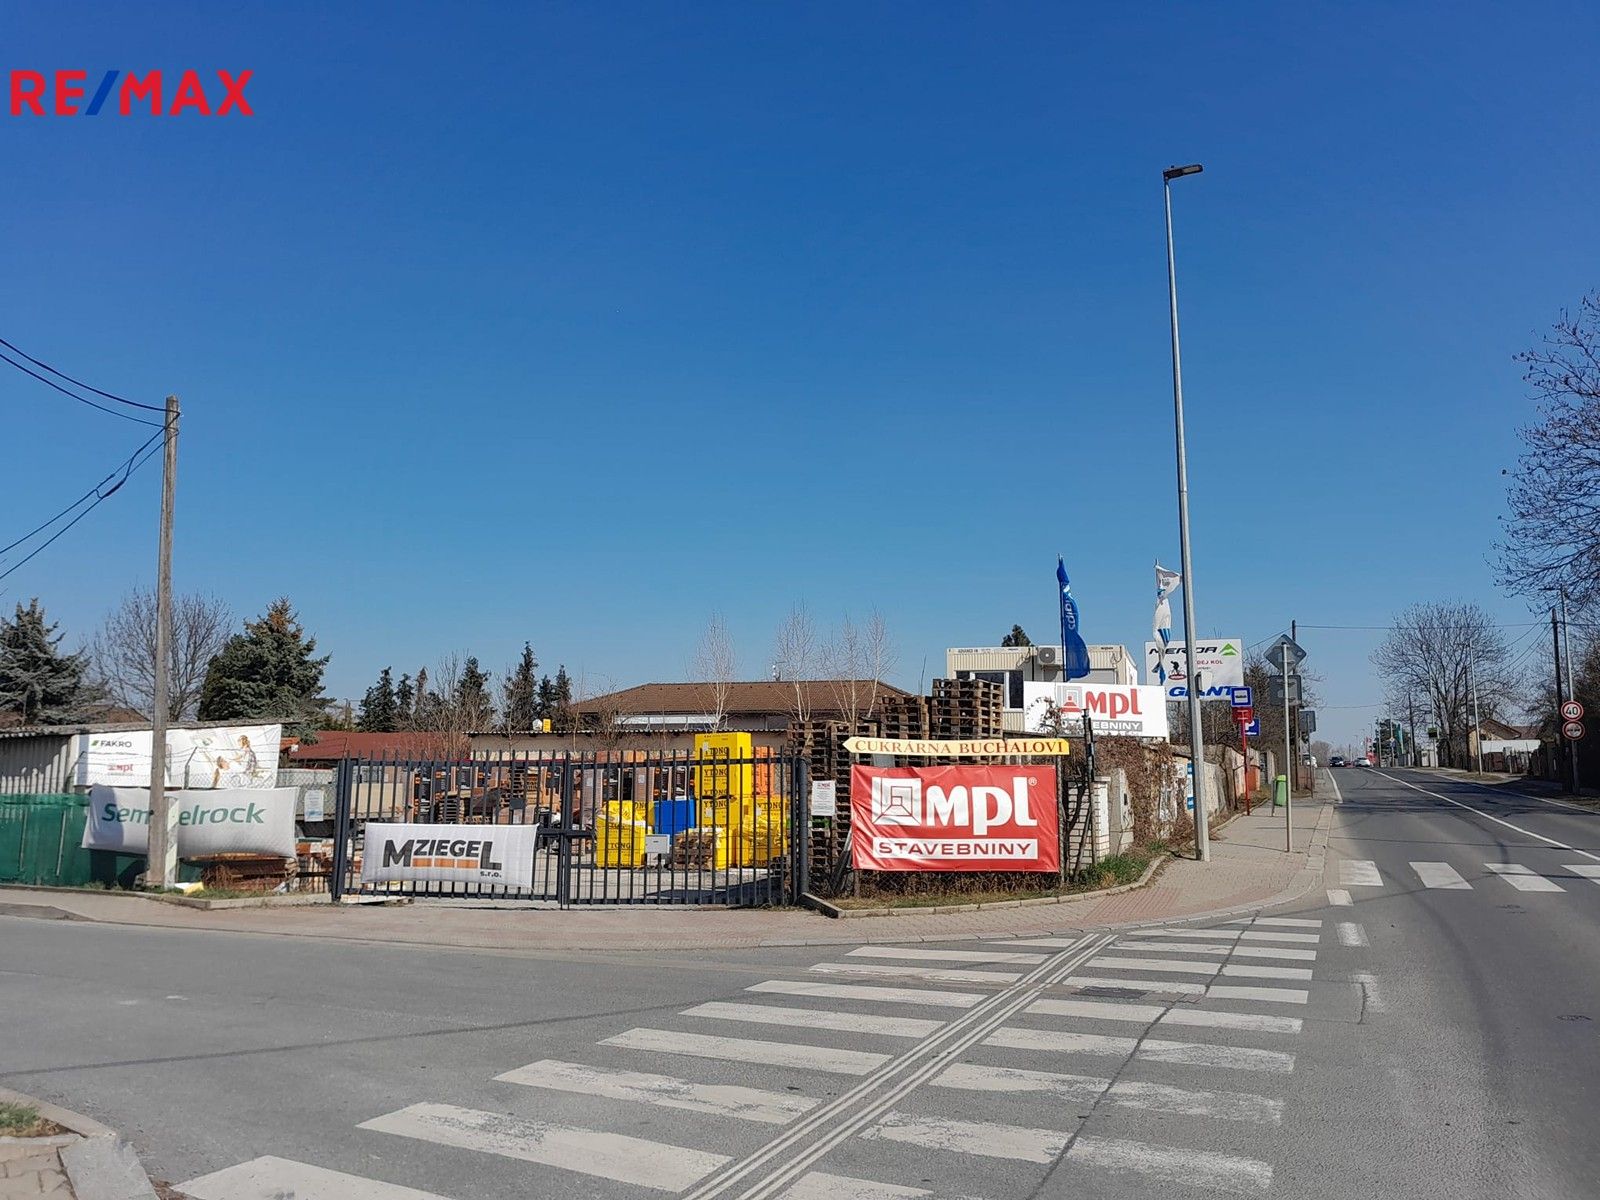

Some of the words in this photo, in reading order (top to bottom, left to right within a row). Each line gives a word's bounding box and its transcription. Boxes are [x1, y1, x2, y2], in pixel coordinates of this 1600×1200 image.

[1566, 706, 1579, 716] 40
[100, 739, 133, 748] FAKRO
[855, 739, 952, 754] CUKRÁRNA
[959, 741, 1064, 754] BUCHALOVI
[101, 802, 267, 827] Semelrock
[878, 842, 1032, 856] STAVEBNINY
[480, 871, 503, 879] s.r.o.
